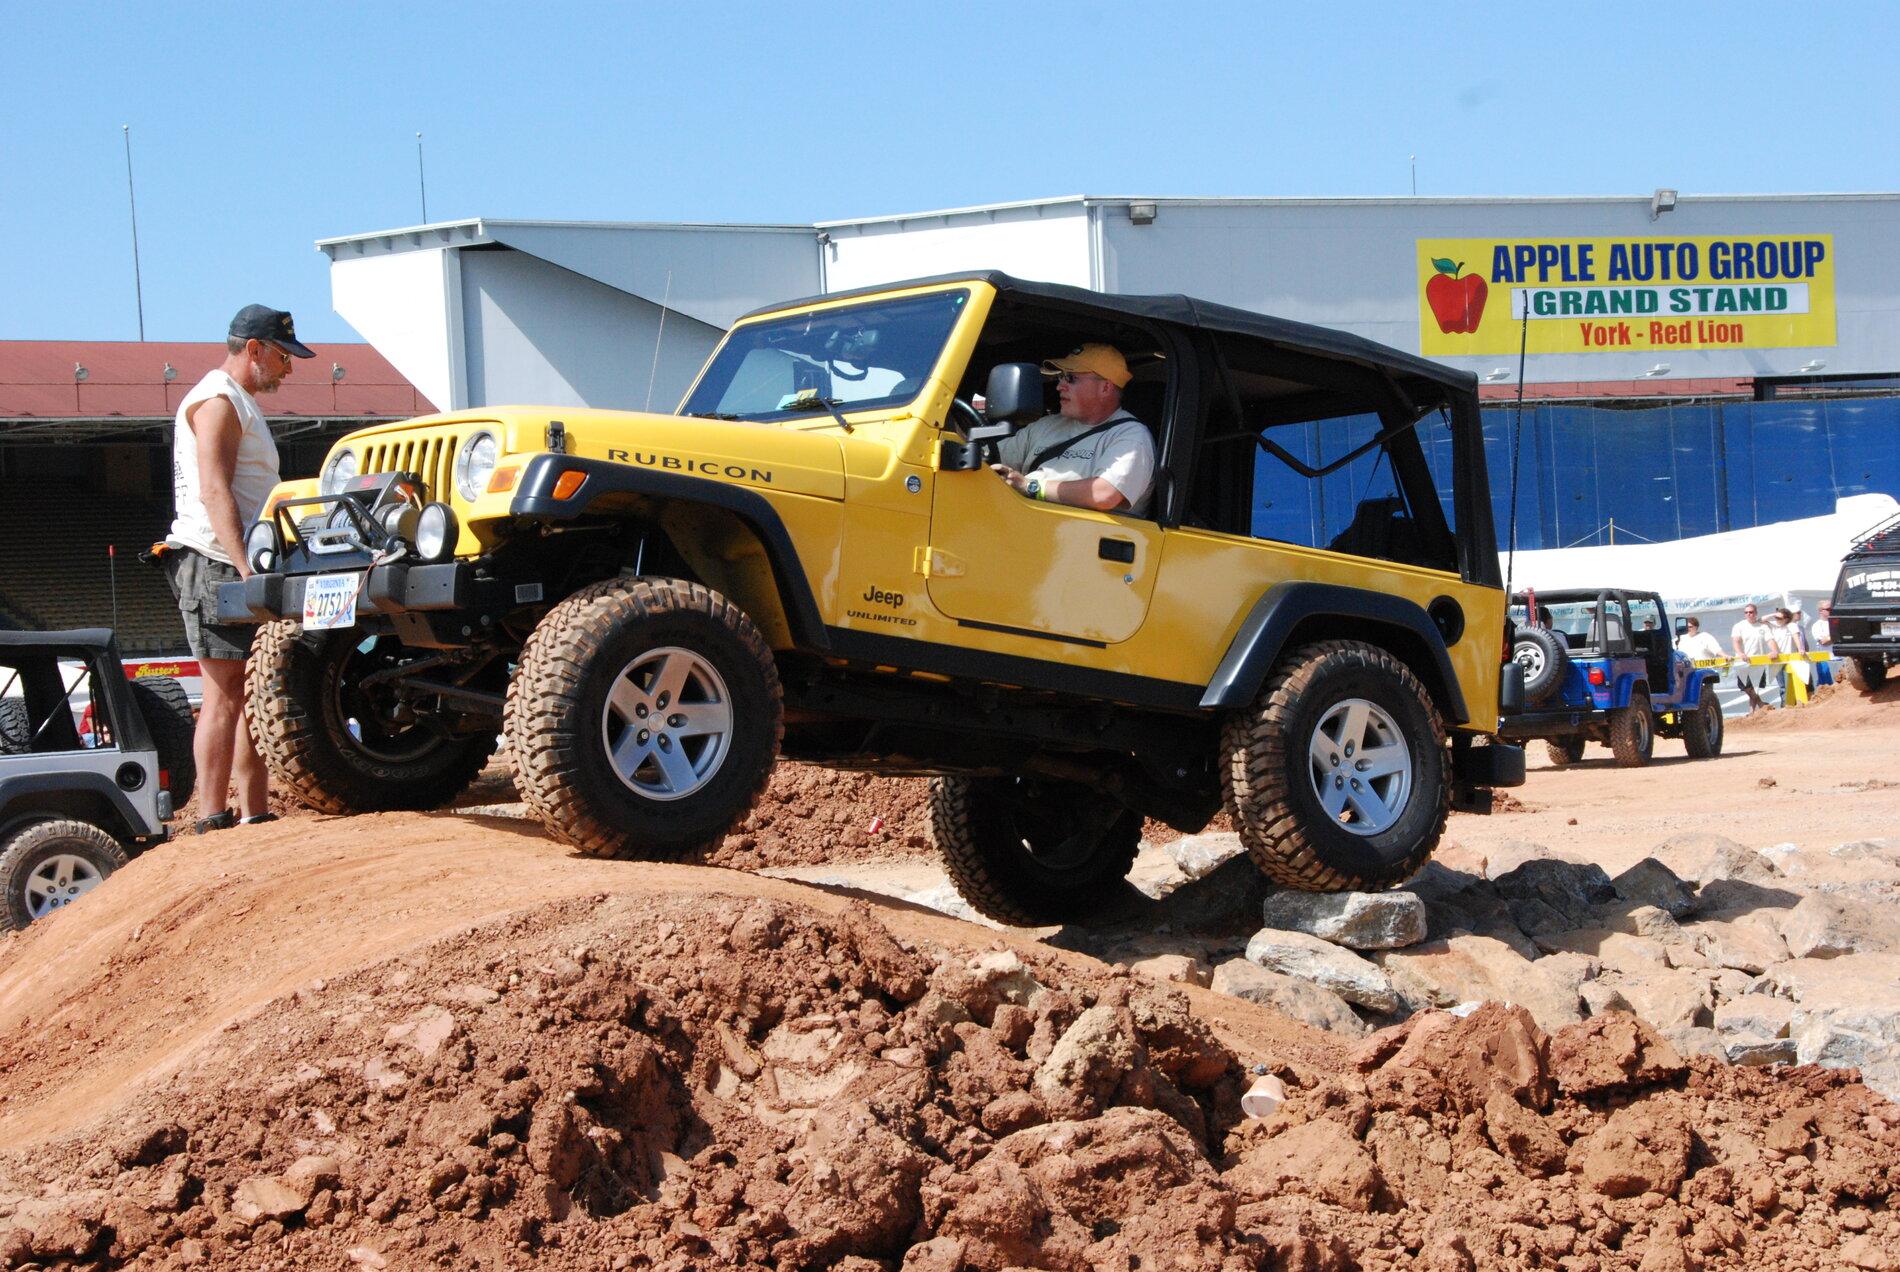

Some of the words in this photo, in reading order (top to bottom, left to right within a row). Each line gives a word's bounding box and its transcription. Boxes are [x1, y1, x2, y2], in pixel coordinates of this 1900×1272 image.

[1491, 243, 1596, 283] APPLE
[1608, 242, 1699, 281] AUTO
[1708, 240, 1825, 280] GROUP
[1532, 288, 1659, 316] GRAND
[1669, 287, 1788, 313] STAND
[1579, 322, 1631, 347] York
[1649, 320, 1692, 345] Red
[1699, 320, 1744, 344] Lion
[608, 448, 772, 483] RUBICON
[863, 585, 904, 609] Jeep
[847, 610, 917, 626] UNLIMITED
